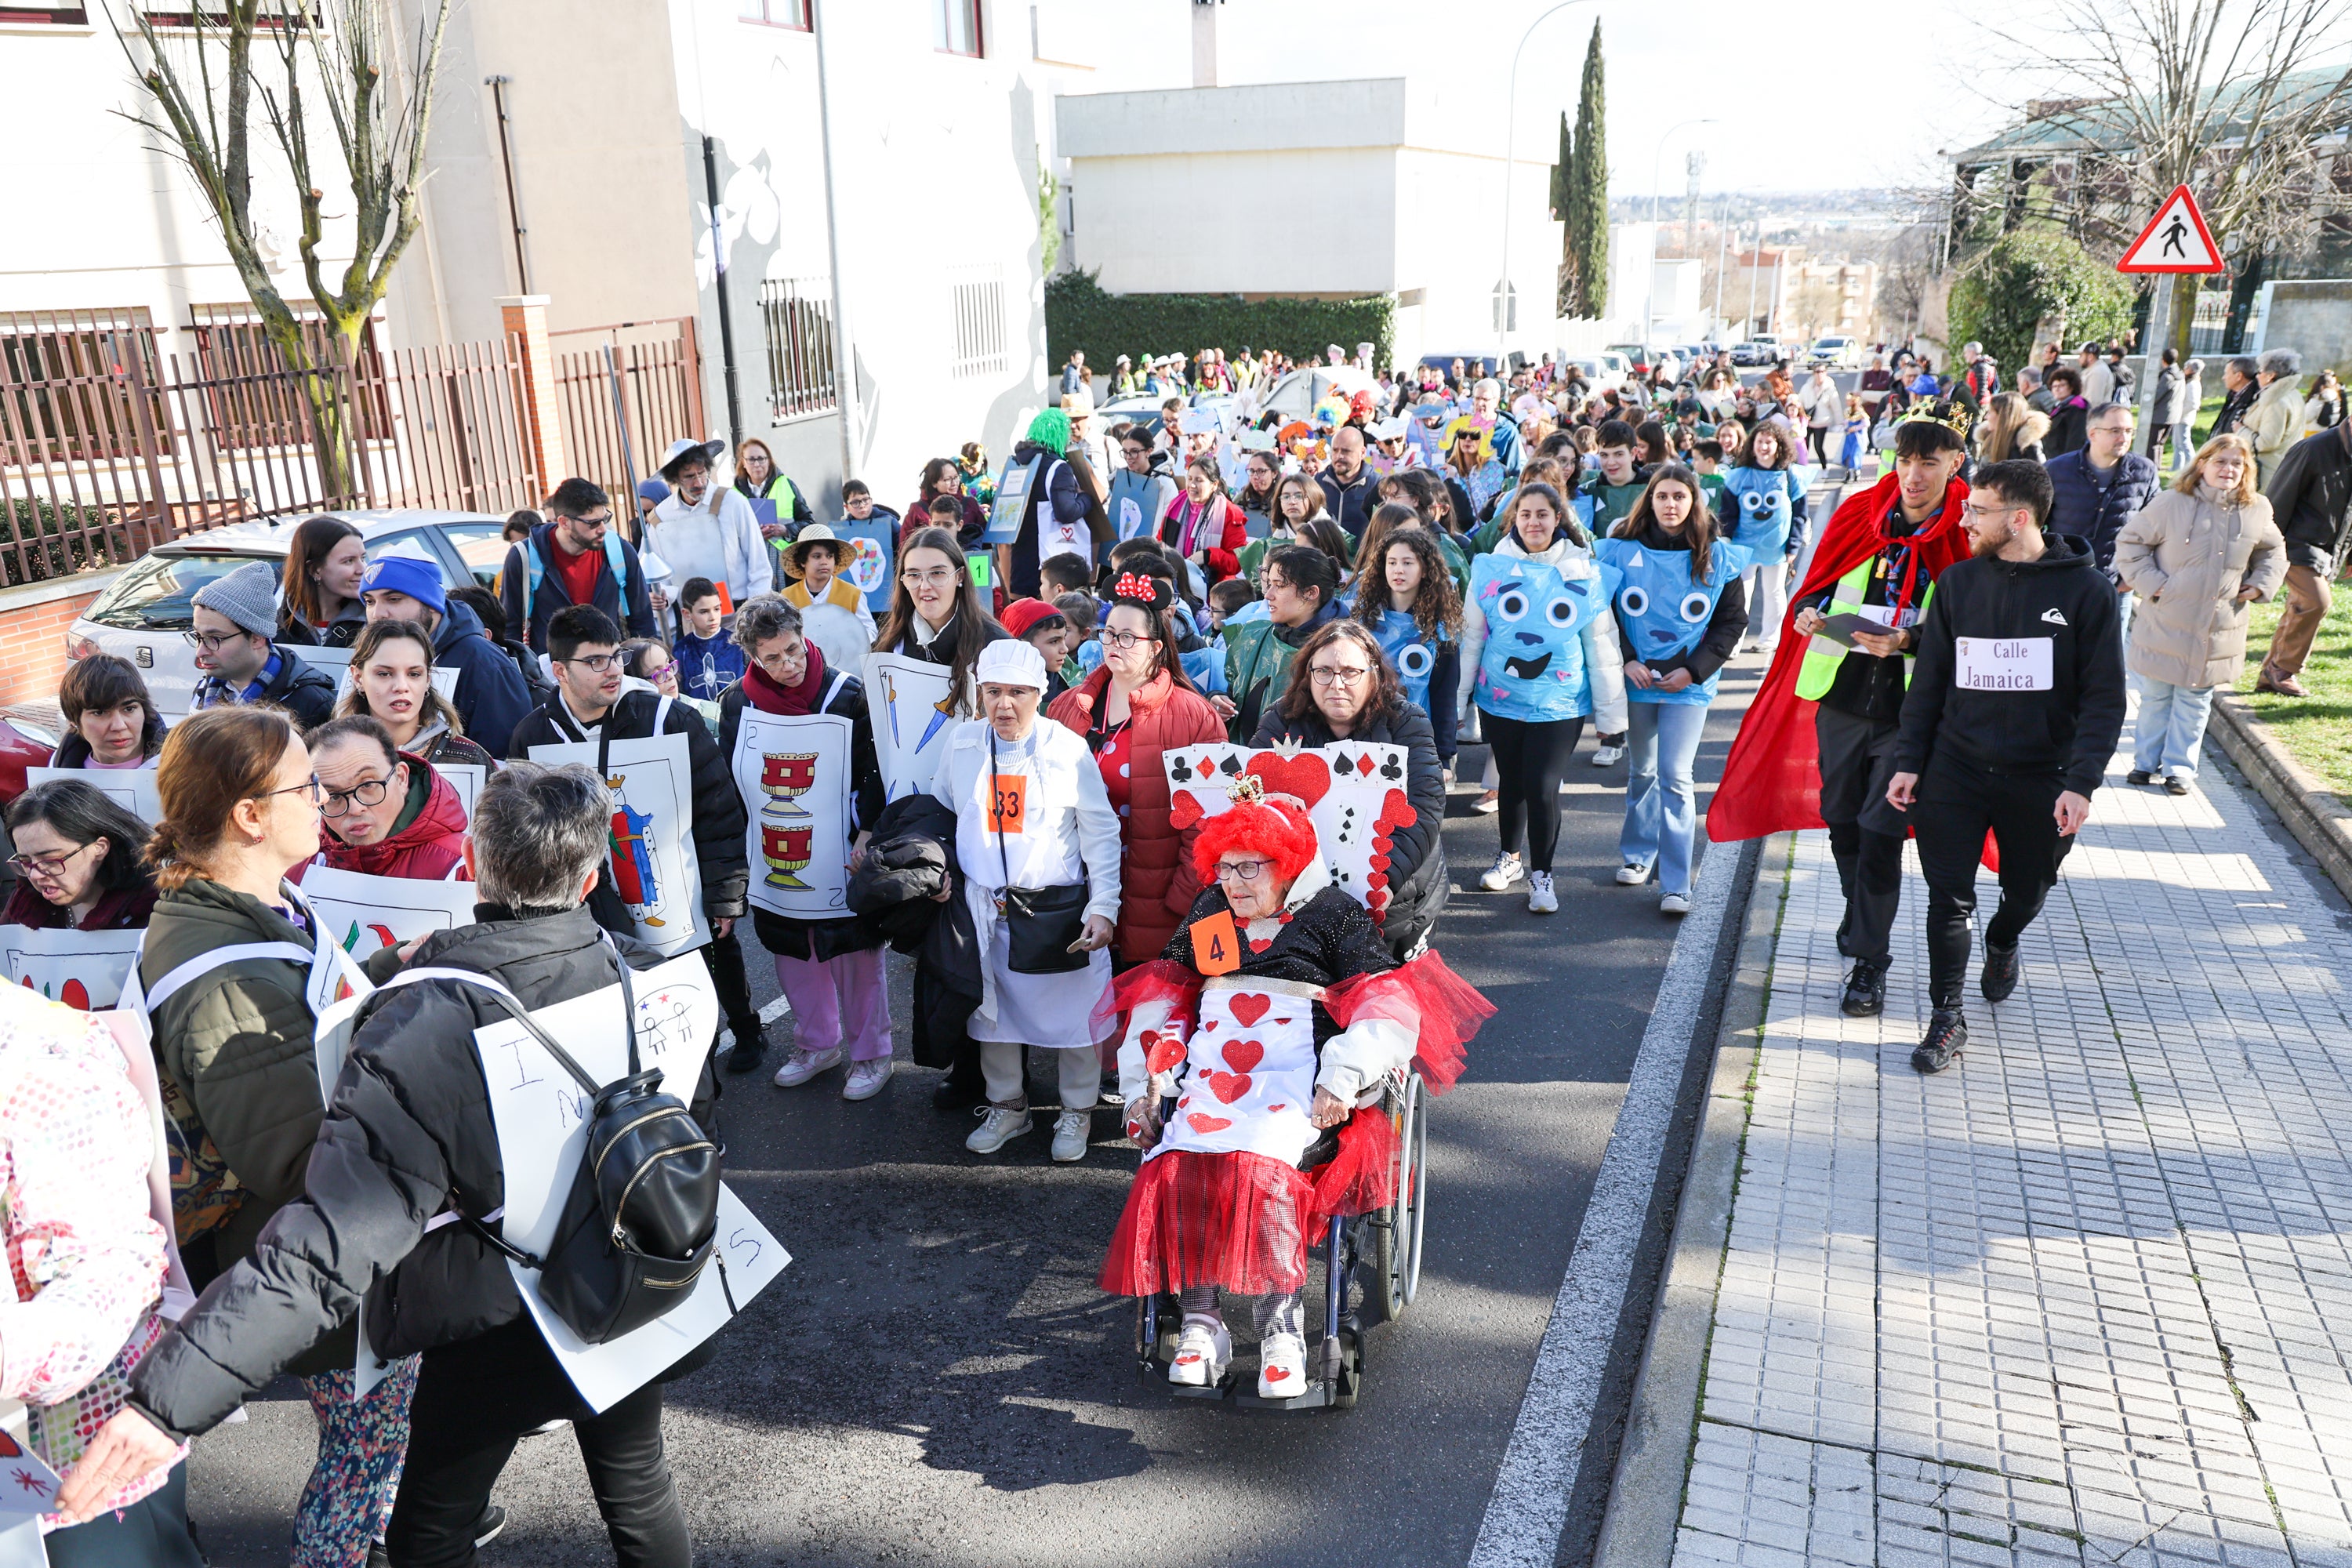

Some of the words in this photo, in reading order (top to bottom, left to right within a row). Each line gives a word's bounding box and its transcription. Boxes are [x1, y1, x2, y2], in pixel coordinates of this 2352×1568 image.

[975, 564, 982, 579] 1
[1882, 610, 1911, 627] Clle
[1994, 641, 2028, 659] Calle
[880, 671, 887, 680] 4
[1965, 666, 2034, 688] Jamaica
[992, 790, 1019, 818] 33
[1210, 934, 1225, 962] 4
